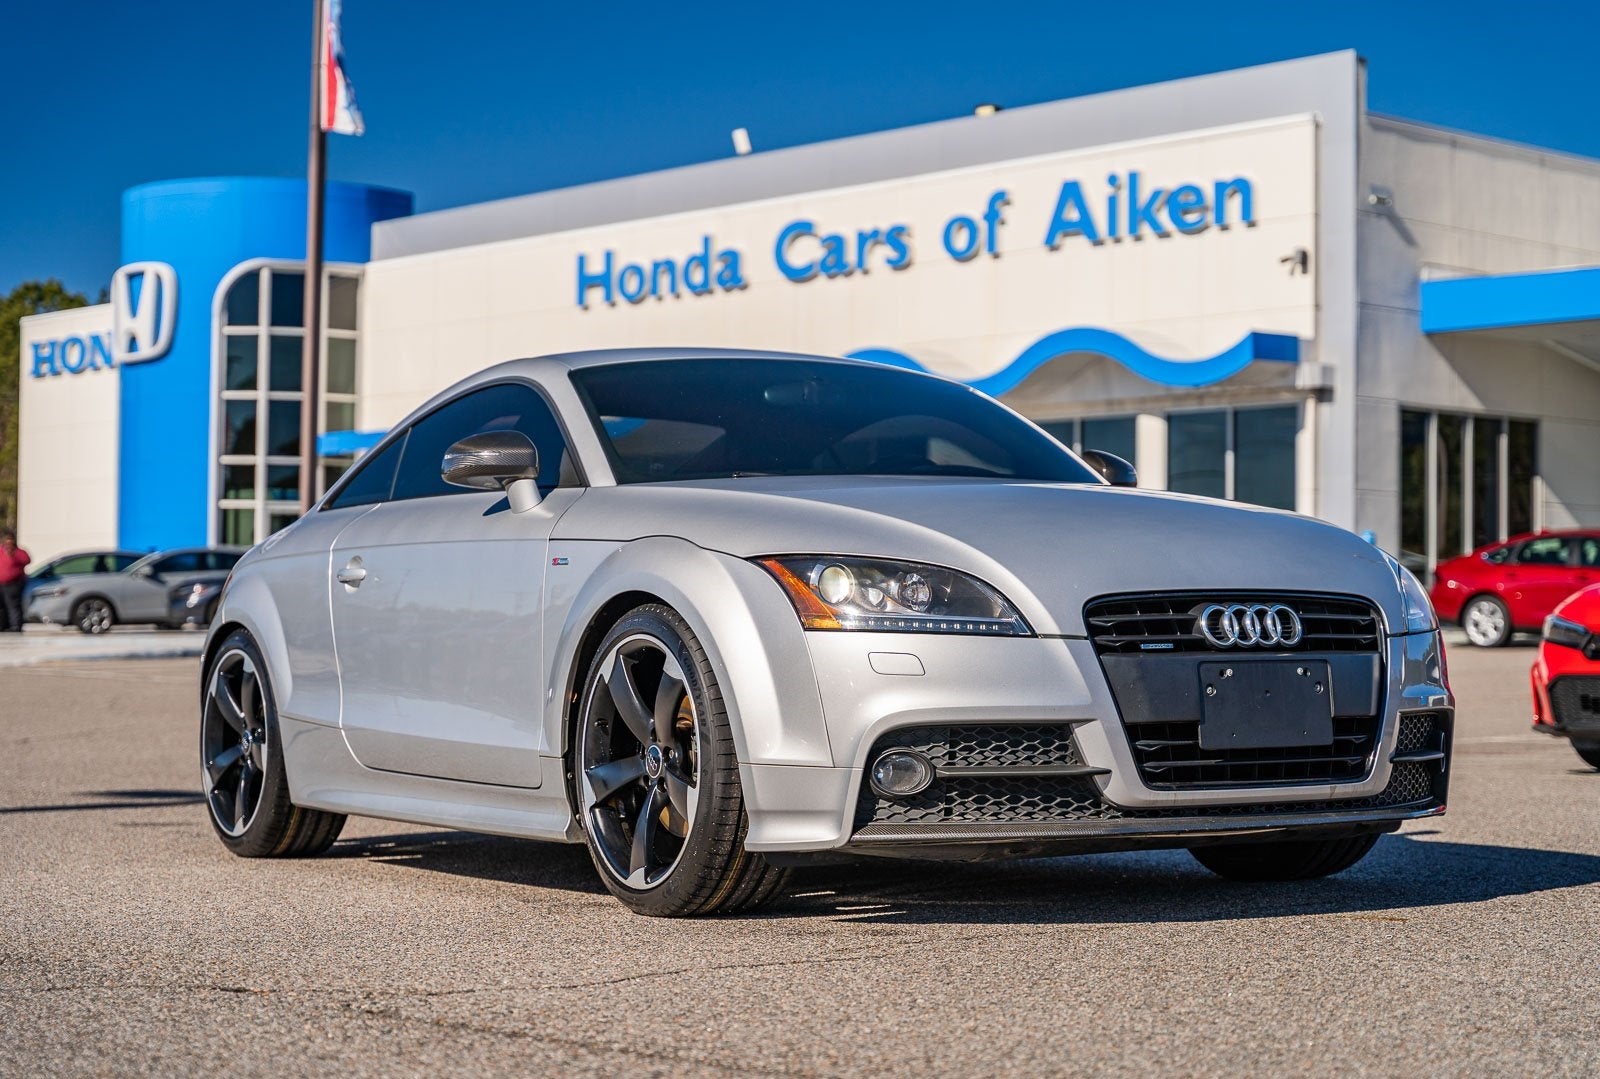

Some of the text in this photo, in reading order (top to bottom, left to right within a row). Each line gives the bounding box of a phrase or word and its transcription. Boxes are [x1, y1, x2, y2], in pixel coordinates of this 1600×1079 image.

[576, 171, 1255, 307] Honda Cars of Aiken
